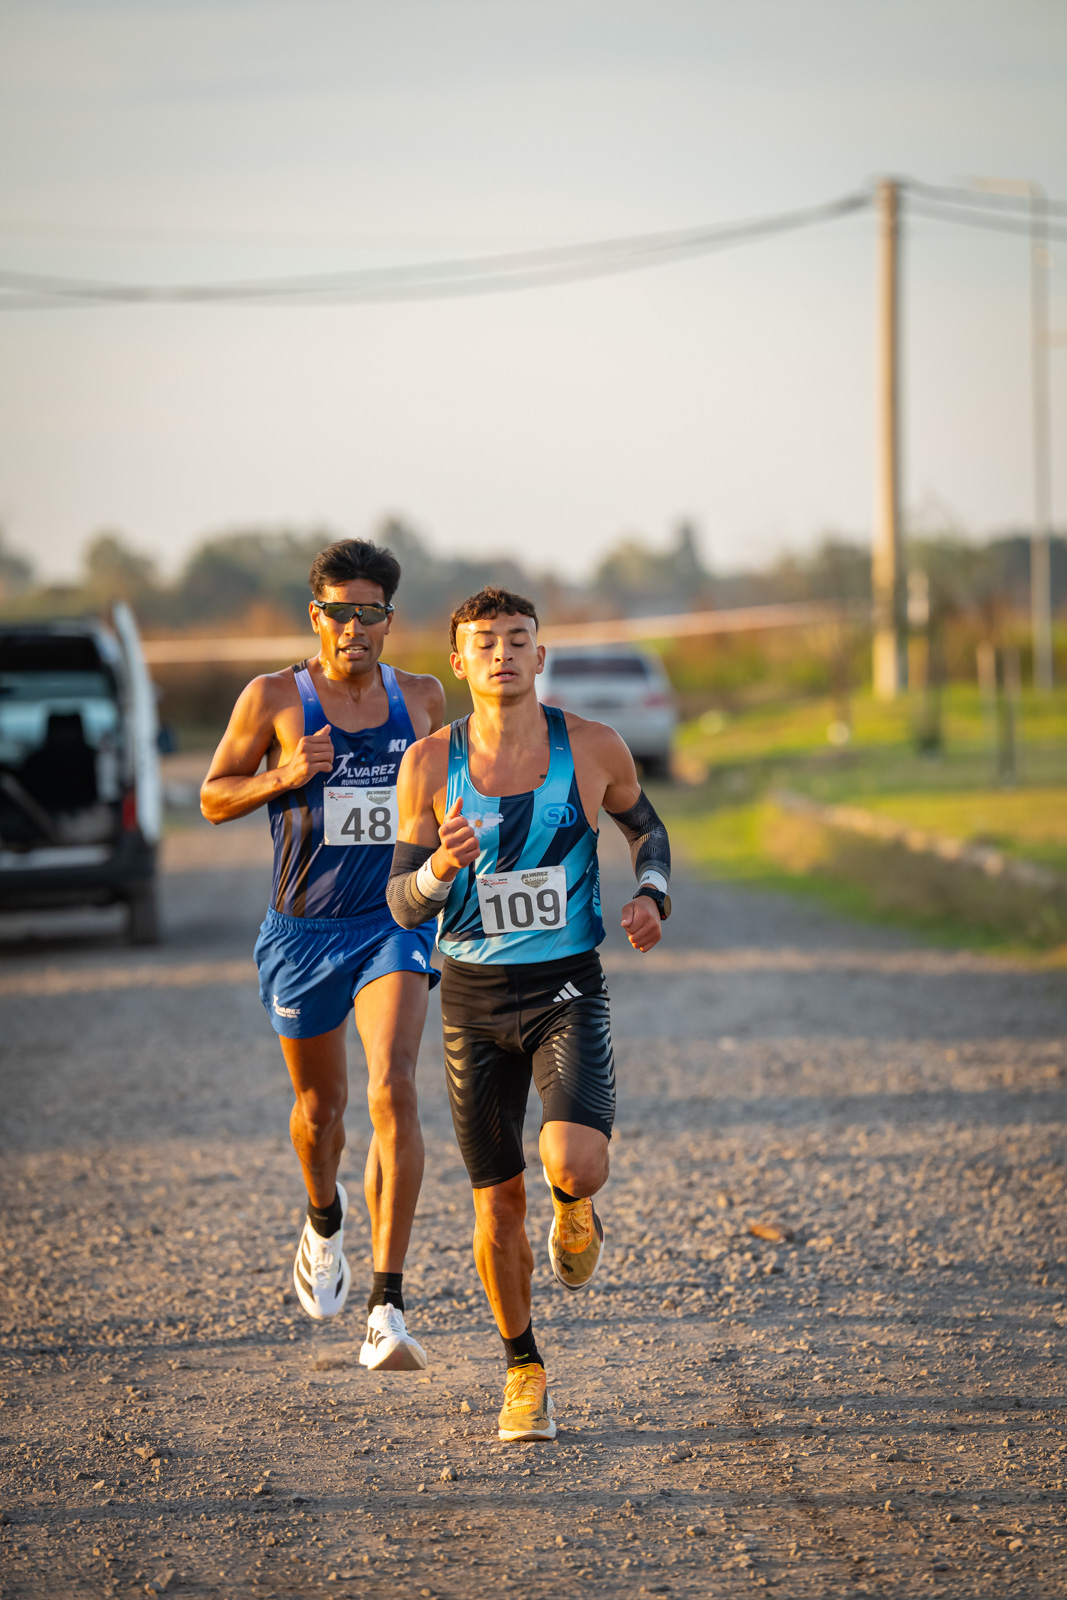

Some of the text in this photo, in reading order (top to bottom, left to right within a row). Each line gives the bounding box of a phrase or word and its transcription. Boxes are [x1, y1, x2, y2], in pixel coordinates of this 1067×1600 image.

[341, 776, 388, 786] RUNNING TEAM
[340, 806, 392, 842] 48
[485, 888, 560, 930] 109
